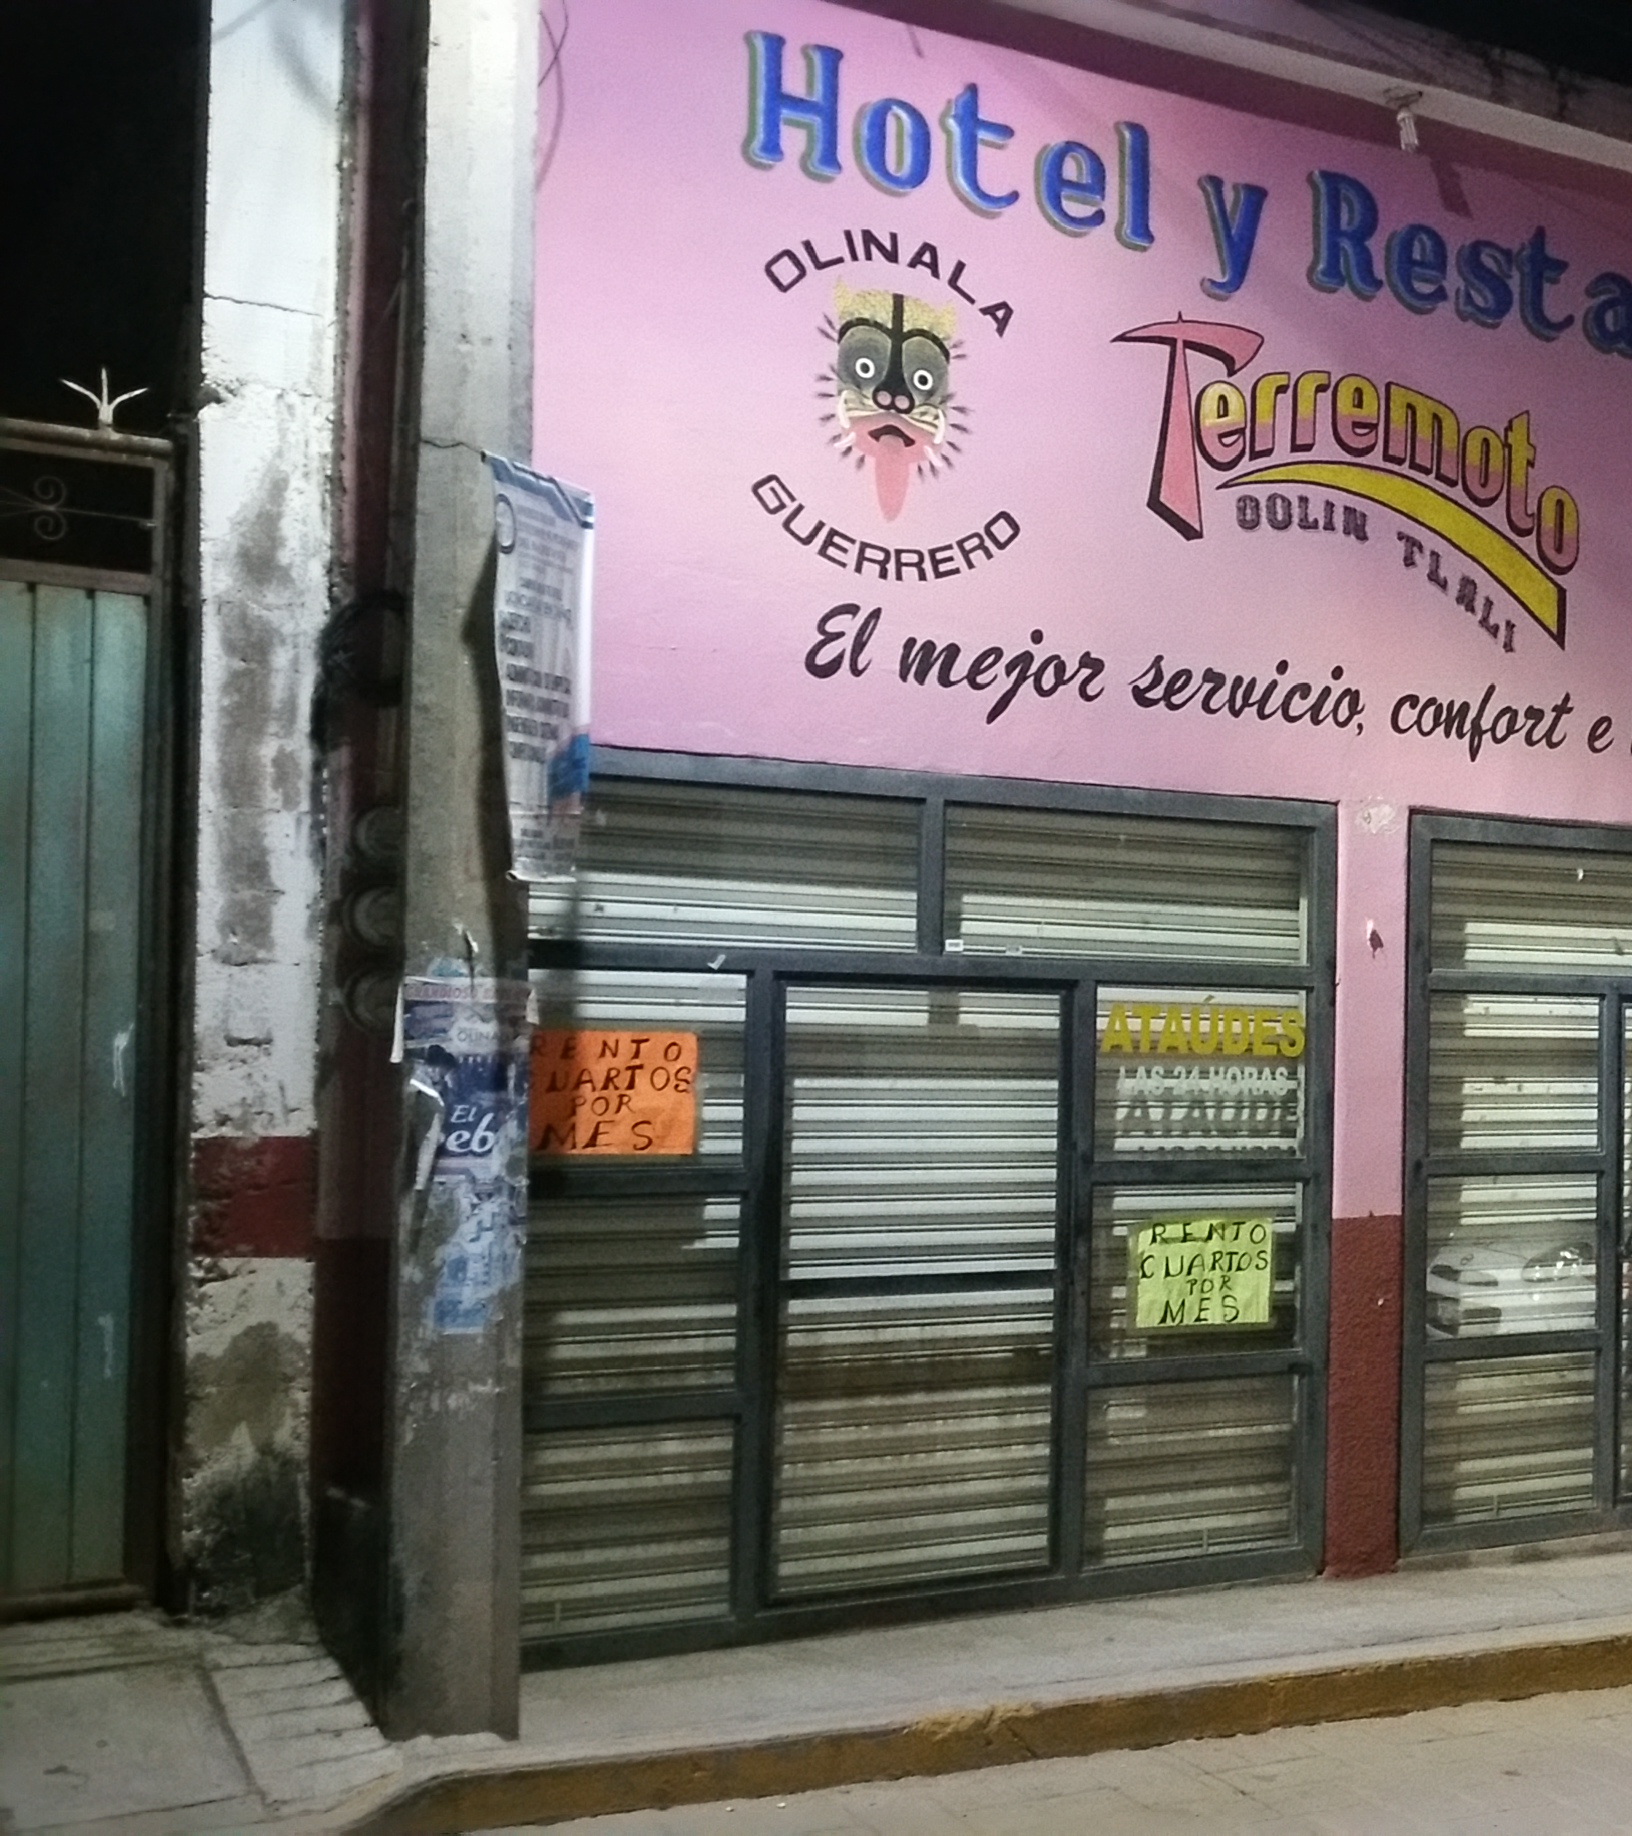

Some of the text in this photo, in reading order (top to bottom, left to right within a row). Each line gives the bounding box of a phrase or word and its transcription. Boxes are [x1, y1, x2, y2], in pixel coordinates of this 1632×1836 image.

[742, 30, 1154, 252] Hotel
[1198, 173, 1267, 301] y
[765, 229, 1014, 338] OLINALA
[1110, 311, 1580, 575] Terremoto
[751, 474, 1021, 582] GUERRERO
[804, 602, 882, 679] El
[899, 629, 1105, 725] mejor
[1129, 655, 1365, 736] servicio,
[1390, 683, 1573, 762] confort
[1587, 714, 1614, 754] e
[545, 1064, 692, 1093] UARTOS
[1116, 1066, 1290, 1096] LAS 24 HORAS
[571, 1094, 635, 1117] POR
[538, 1120, 653, 1151] MES
[1149, 1221, 1266, 1246] RENTO
[1140, 1250, 1269, 1279] CUARTOS
[1186, 1274, 1232, 1296] POR
[1158, 1295, 1240, 1325] MES
